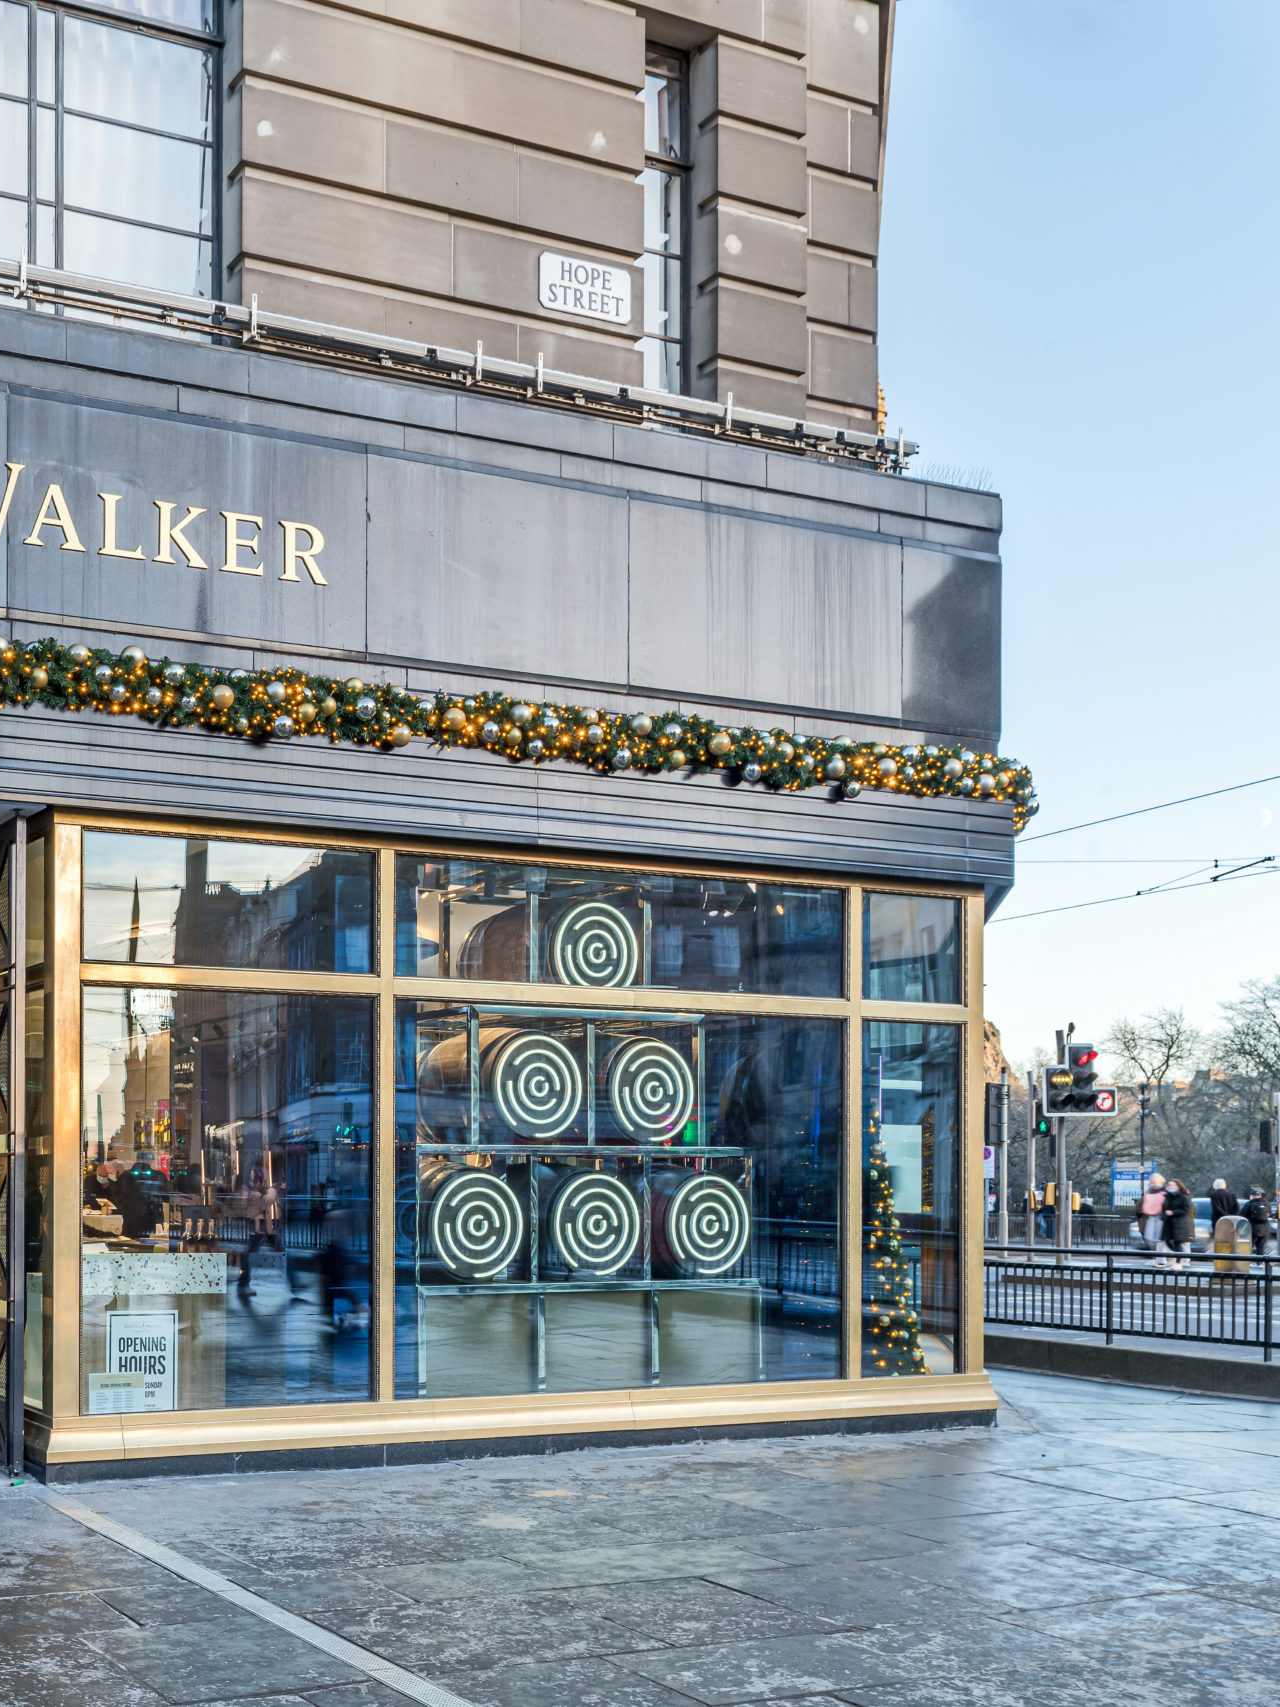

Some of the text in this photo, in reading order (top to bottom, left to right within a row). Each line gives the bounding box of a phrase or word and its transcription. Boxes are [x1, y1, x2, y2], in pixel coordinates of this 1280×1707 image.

[560, 261, 612, 291] HOPE
[548, 283, 624, 317] STREET
[118, 1336, 167, 1353] OPENING
[118, 1355, 166, 1375] HOURS
